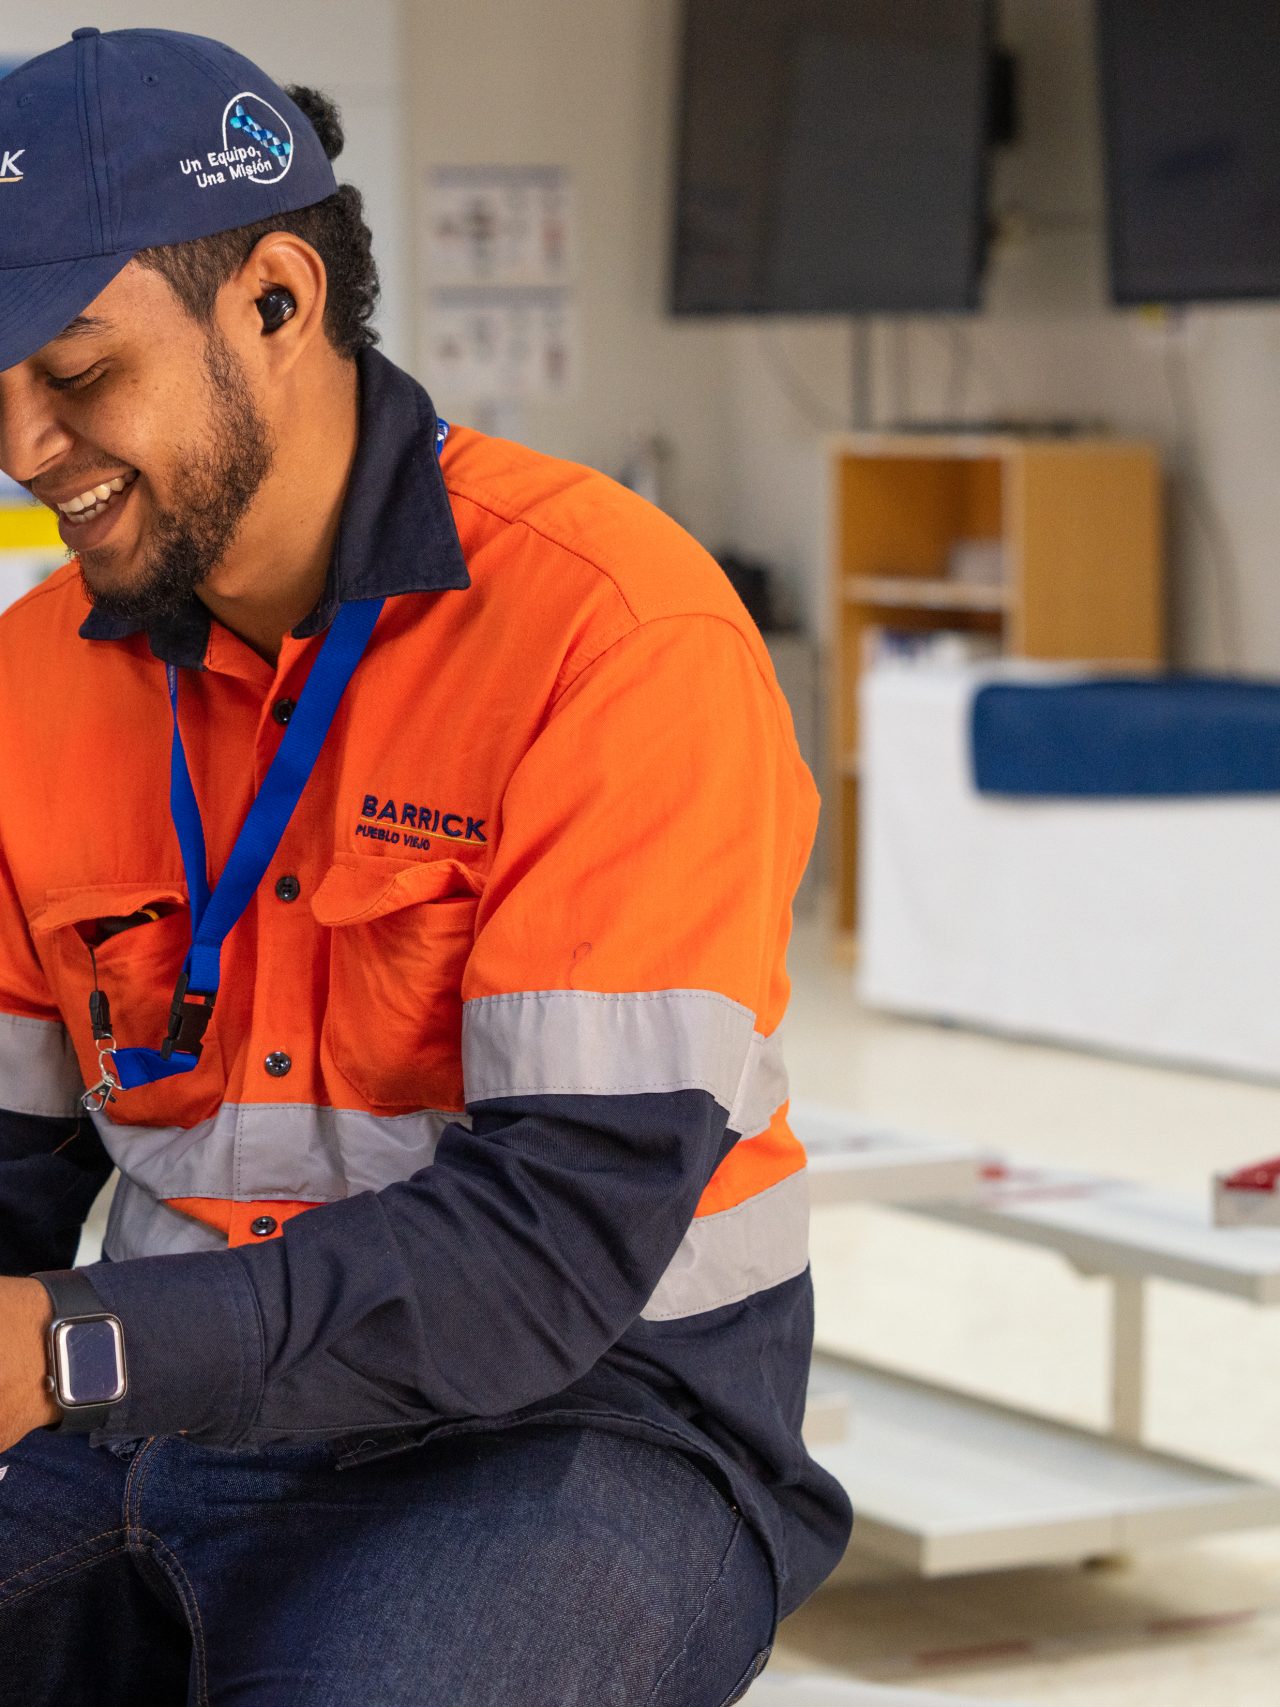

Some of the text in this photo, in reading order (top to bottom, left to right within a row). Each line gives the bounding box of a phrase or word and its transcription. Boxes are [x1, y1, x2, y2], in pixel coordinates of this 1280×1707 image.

[180, 145, 261, 175] Un Equipo,
[196, 159, 272, 188] Una Misión
[361, 794, 488, 842] BARRICK
[355, 824, 431, 851] PUEBLO VIEJO
